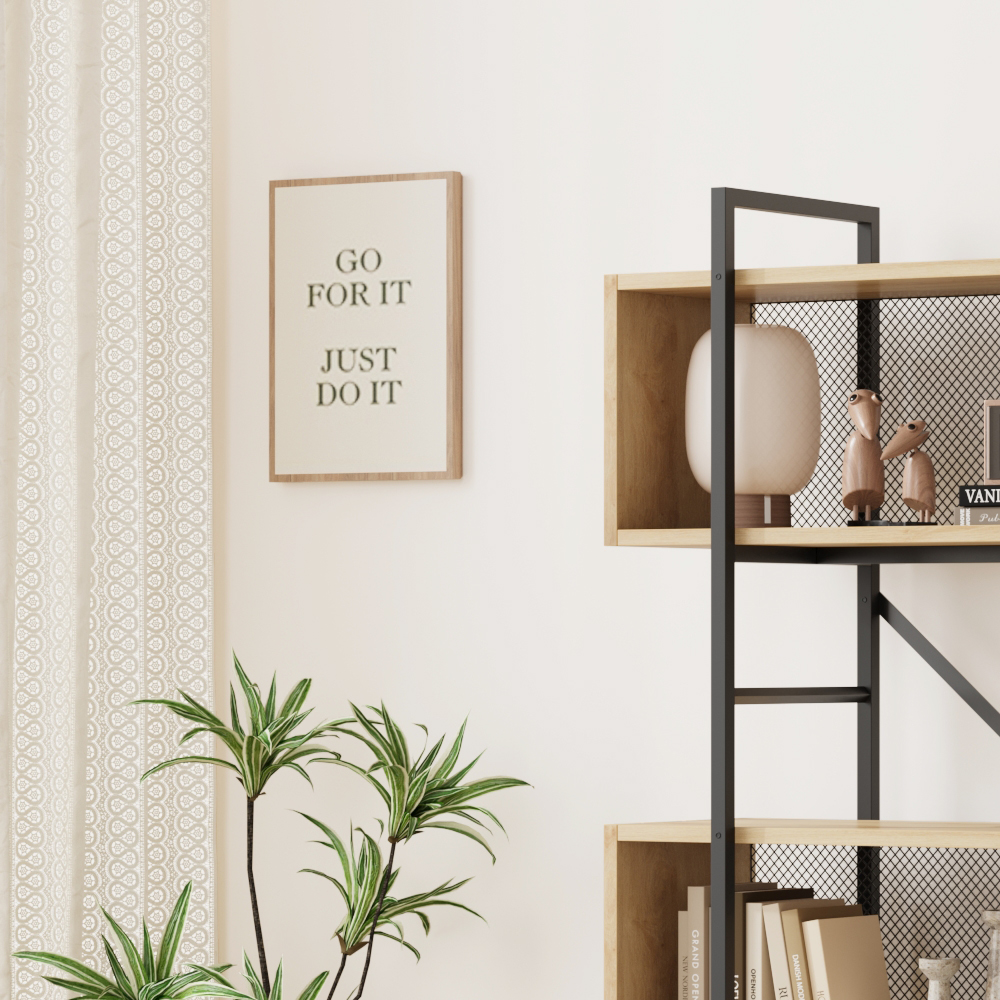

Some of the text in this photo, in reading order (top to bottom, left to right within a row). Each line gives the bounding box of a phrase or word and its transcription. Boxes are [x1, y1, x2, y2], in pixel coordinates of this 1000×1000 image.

[336, 248, 382, 274] GO
[306, 280, 412, 308] FOR IT
[321, 347, 397, 374] JUST
[316, 380, 402, 406] DO IT
[691, 929, 700, 969] GRAND
[791, 954, 802, 981] DANISH
